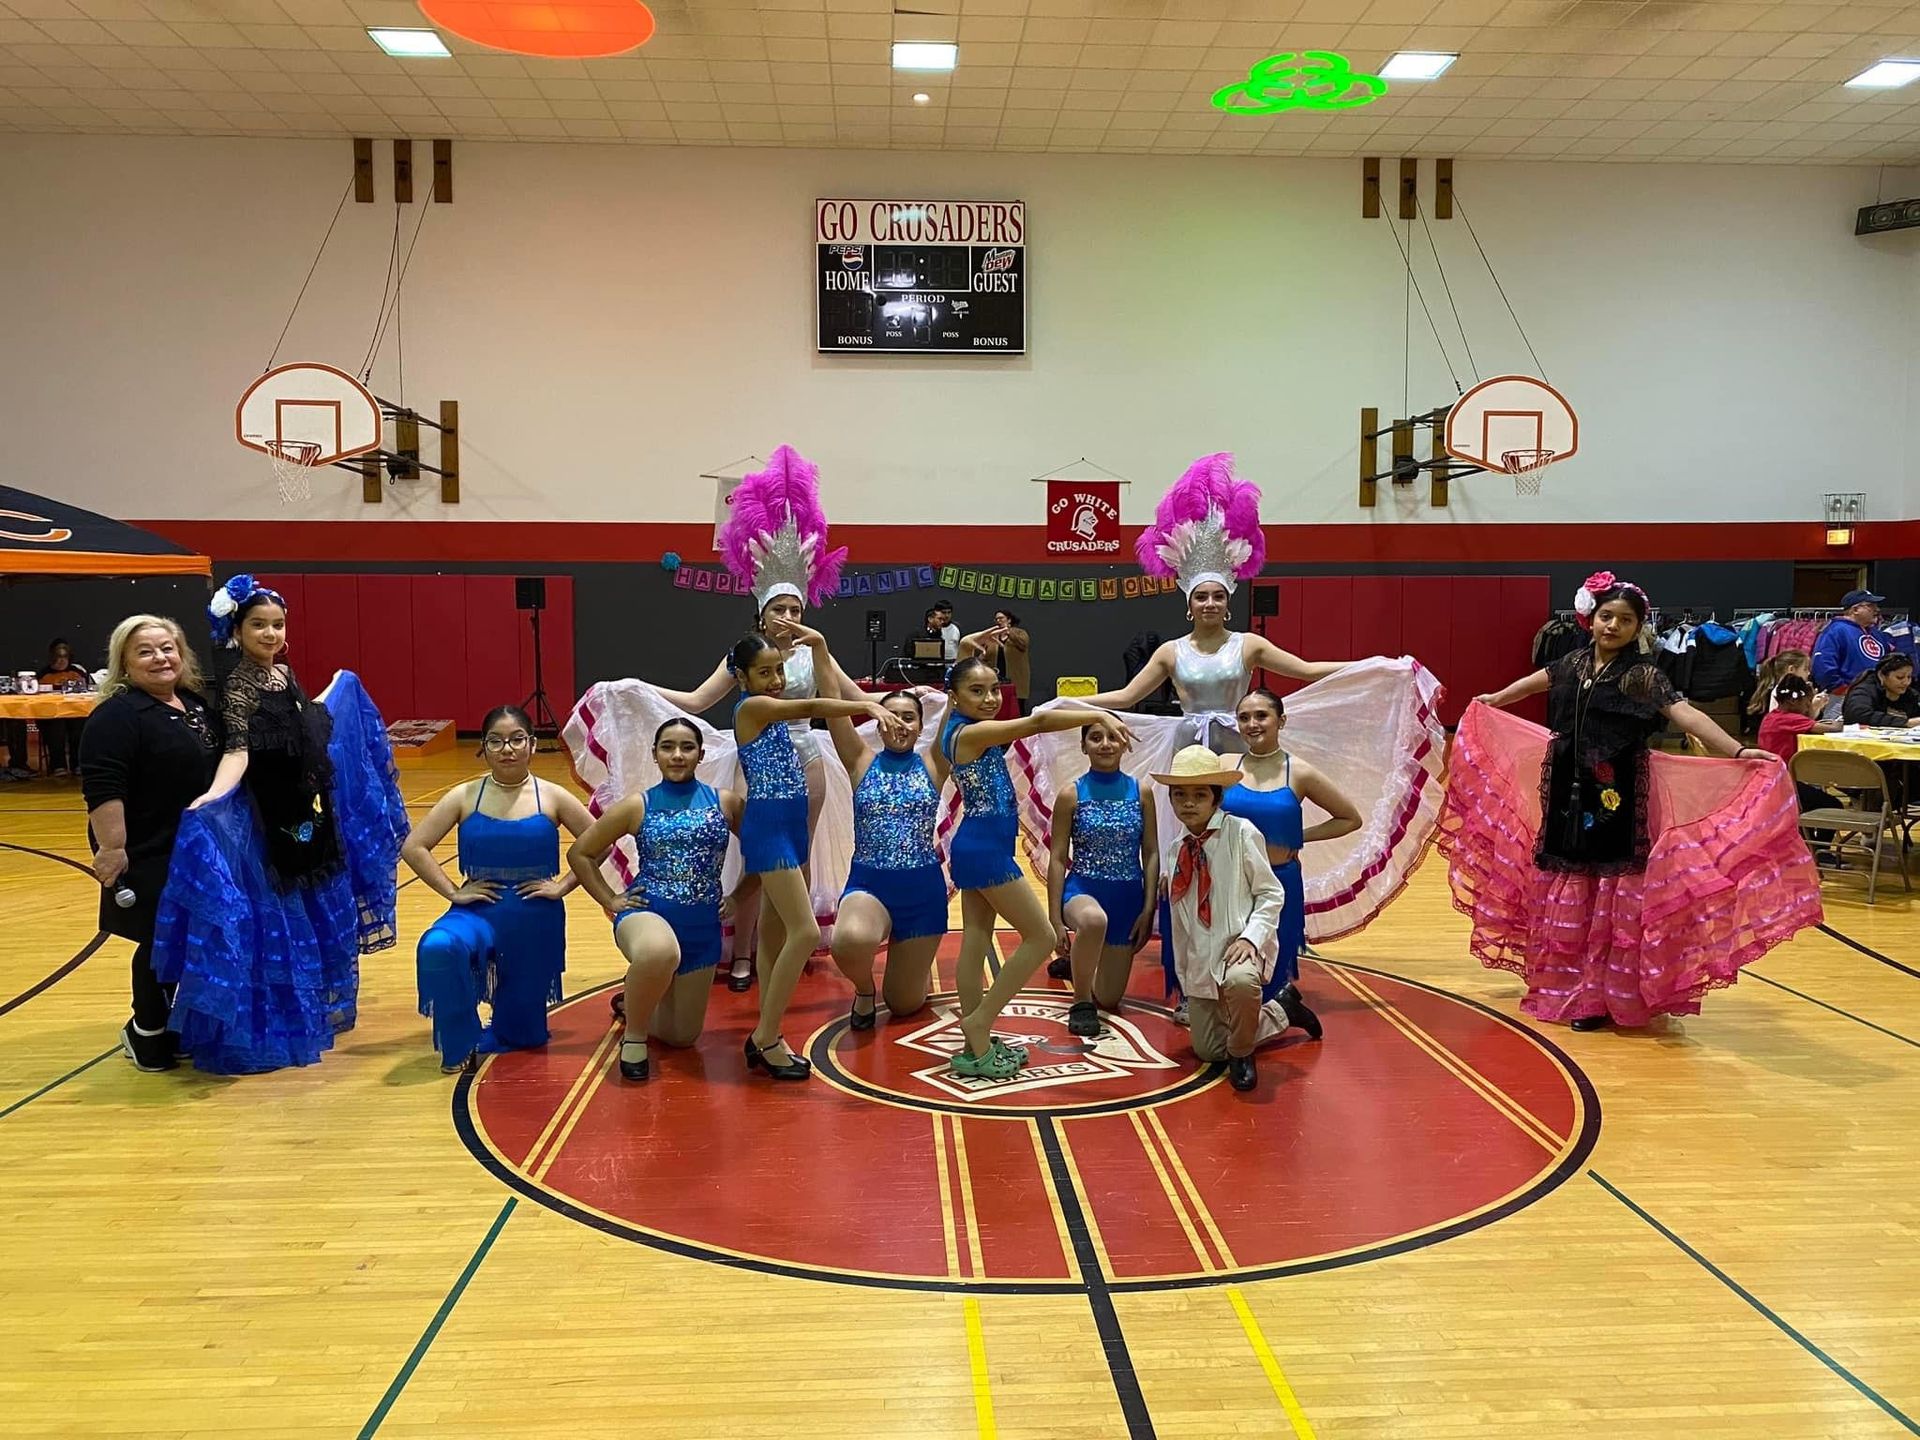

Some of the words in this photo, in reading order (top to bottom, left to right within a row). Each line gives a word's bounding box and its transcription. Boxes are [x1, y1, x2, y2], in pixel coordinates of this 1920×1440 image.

[820, 202, 858, 241] GO
[870, 203, 1022, 243] CRUSADERS
[829, 244, 865, 255] PEPSI
[825, 270, 870, 291] HOME
[973, 272, 1018, 293] GUEST
[901, 294, 945, 303] PERIOD
[837, 336, 873, 345] BONUS
[973, 337, 1009, 346] BONUS
[1051, 498, 1069, 514] GO
[1073, 493, 1118, 520] WHITE
[1047, 540, 1120, 552] CRUSADERS
[942, 567, 1094, 596] HERITAGE
